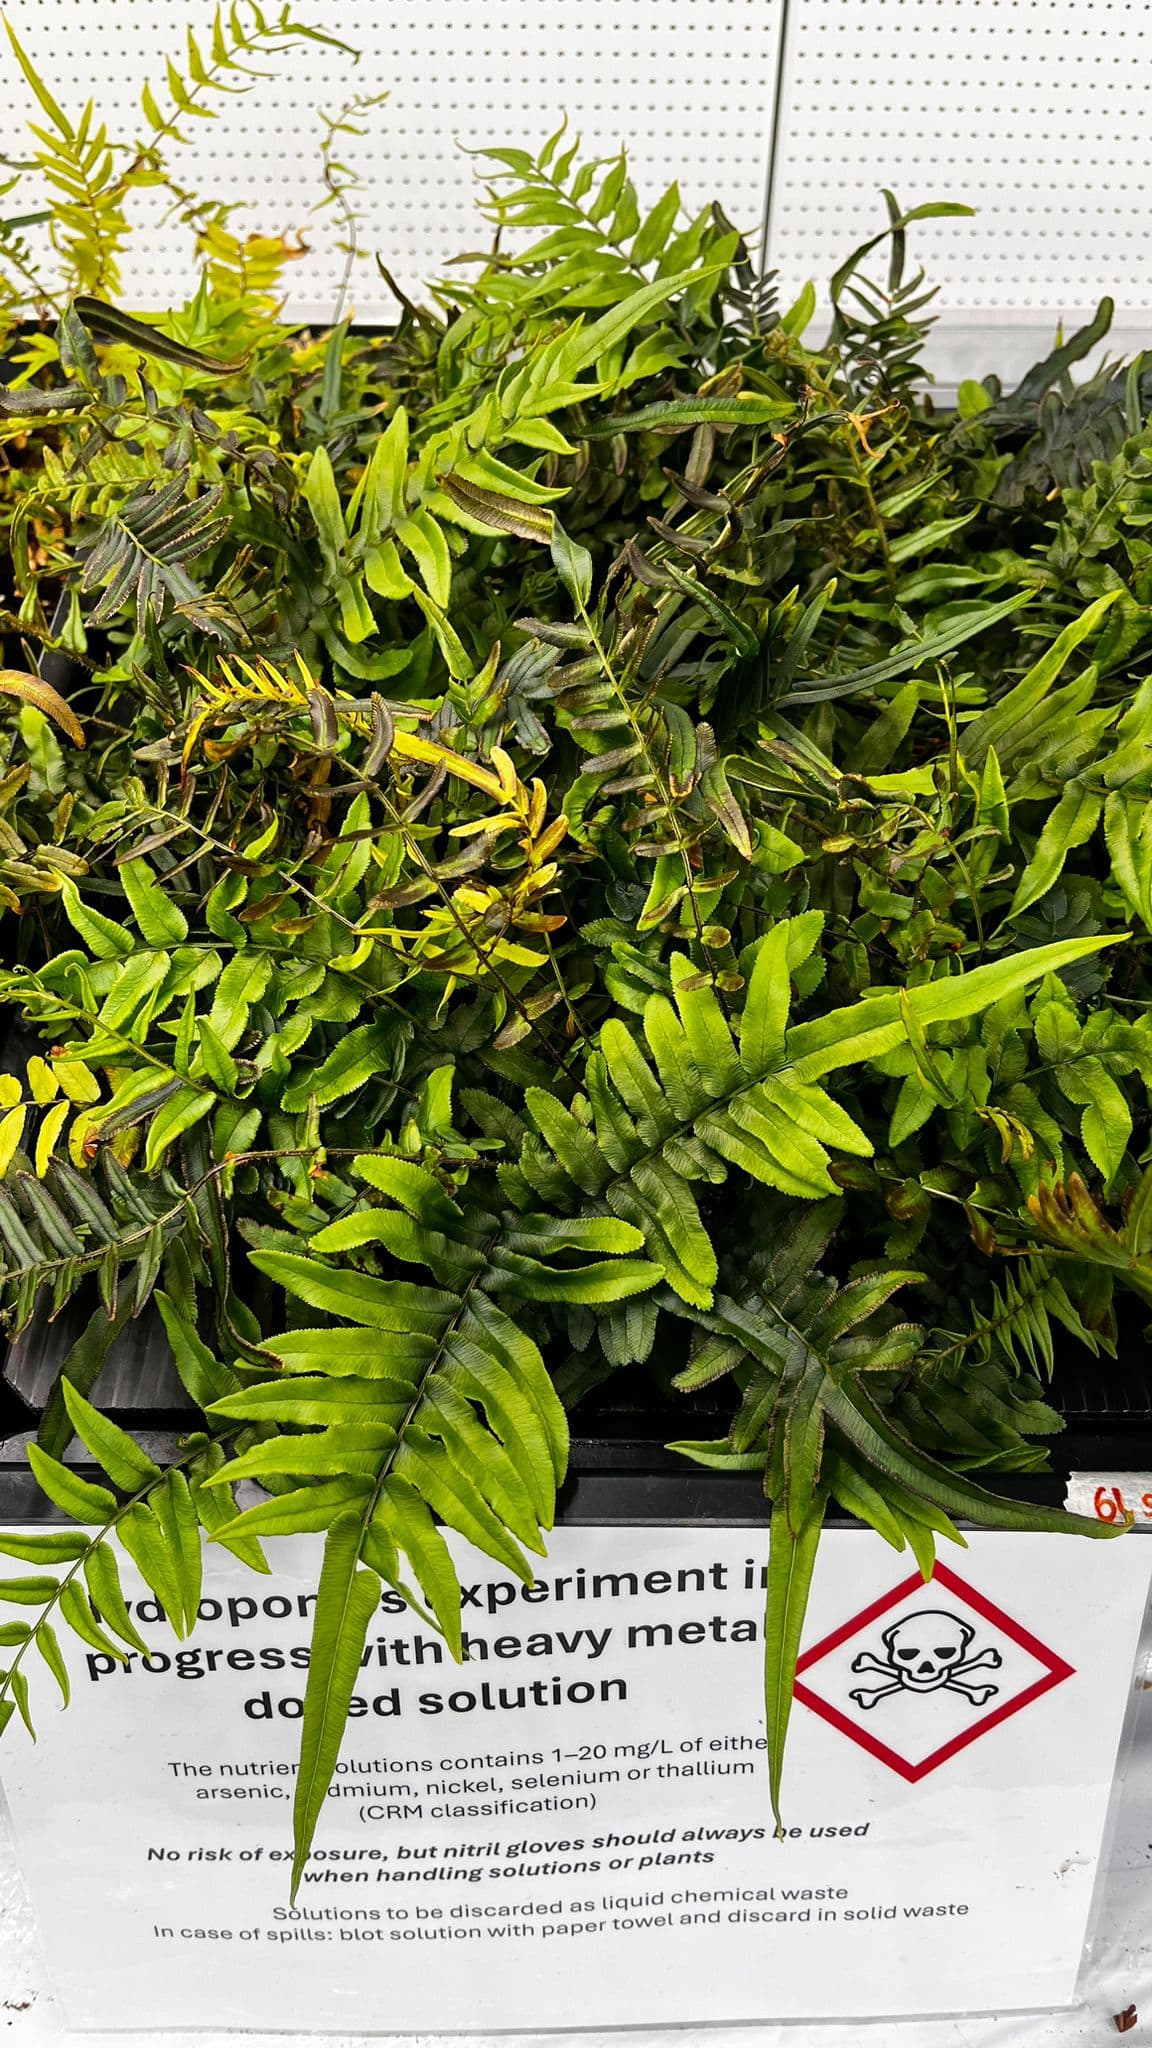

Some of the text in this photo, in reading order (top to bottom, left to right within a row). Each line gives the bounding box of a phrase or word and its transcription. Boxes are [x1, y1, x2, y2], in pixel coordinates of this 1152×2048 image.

[88, 1559, 768, 1627] dopons xperiment i
[86, 1647, 311, 1682] progress
[462, 1628, 612, 1661] heavy
[628, 1616, 767, 1648] meta
[244, 1676, 626, 1720] doed solution
[168, 1763, 212, 1776] The
[336, 1758, 432, 1774] olutions
[440, 1753, 543, 1770] contains
[615, 1740, 673, 1759] mg/L
[680, 1737, 703, 1752] of
[710, 1736, 768, 1751] eithe
[197, 1761, 753, 1800] arsenic, dmium, nickel, selenium or thallium
[359, 1793, 597, 1823] (CRM classification)
[148, 1848, 180, 1861] No
[188, 1848, 232, 1861] risk
[239, 1848, 263, 1861] of
[397, 1846, 438, 1859] but
[444, 1842, 500, 1858] nitril
[505, 1839, 585, 1858] gloves
[592, 1829, 676, 1848] should
[682, 1827, 765, 1842] always
[773, 1825, 803, 1839] be
[810, 1823, 870, 1837] used
[304, 1851, 714, 1882] when handling solutions or plants
[154, 1904, 968, 1943] In case of spills: blot solution with paper towel and discard in solid waste
[274, 1888, 847, 1920] Solutions to be discarded as liquid chemical waste
